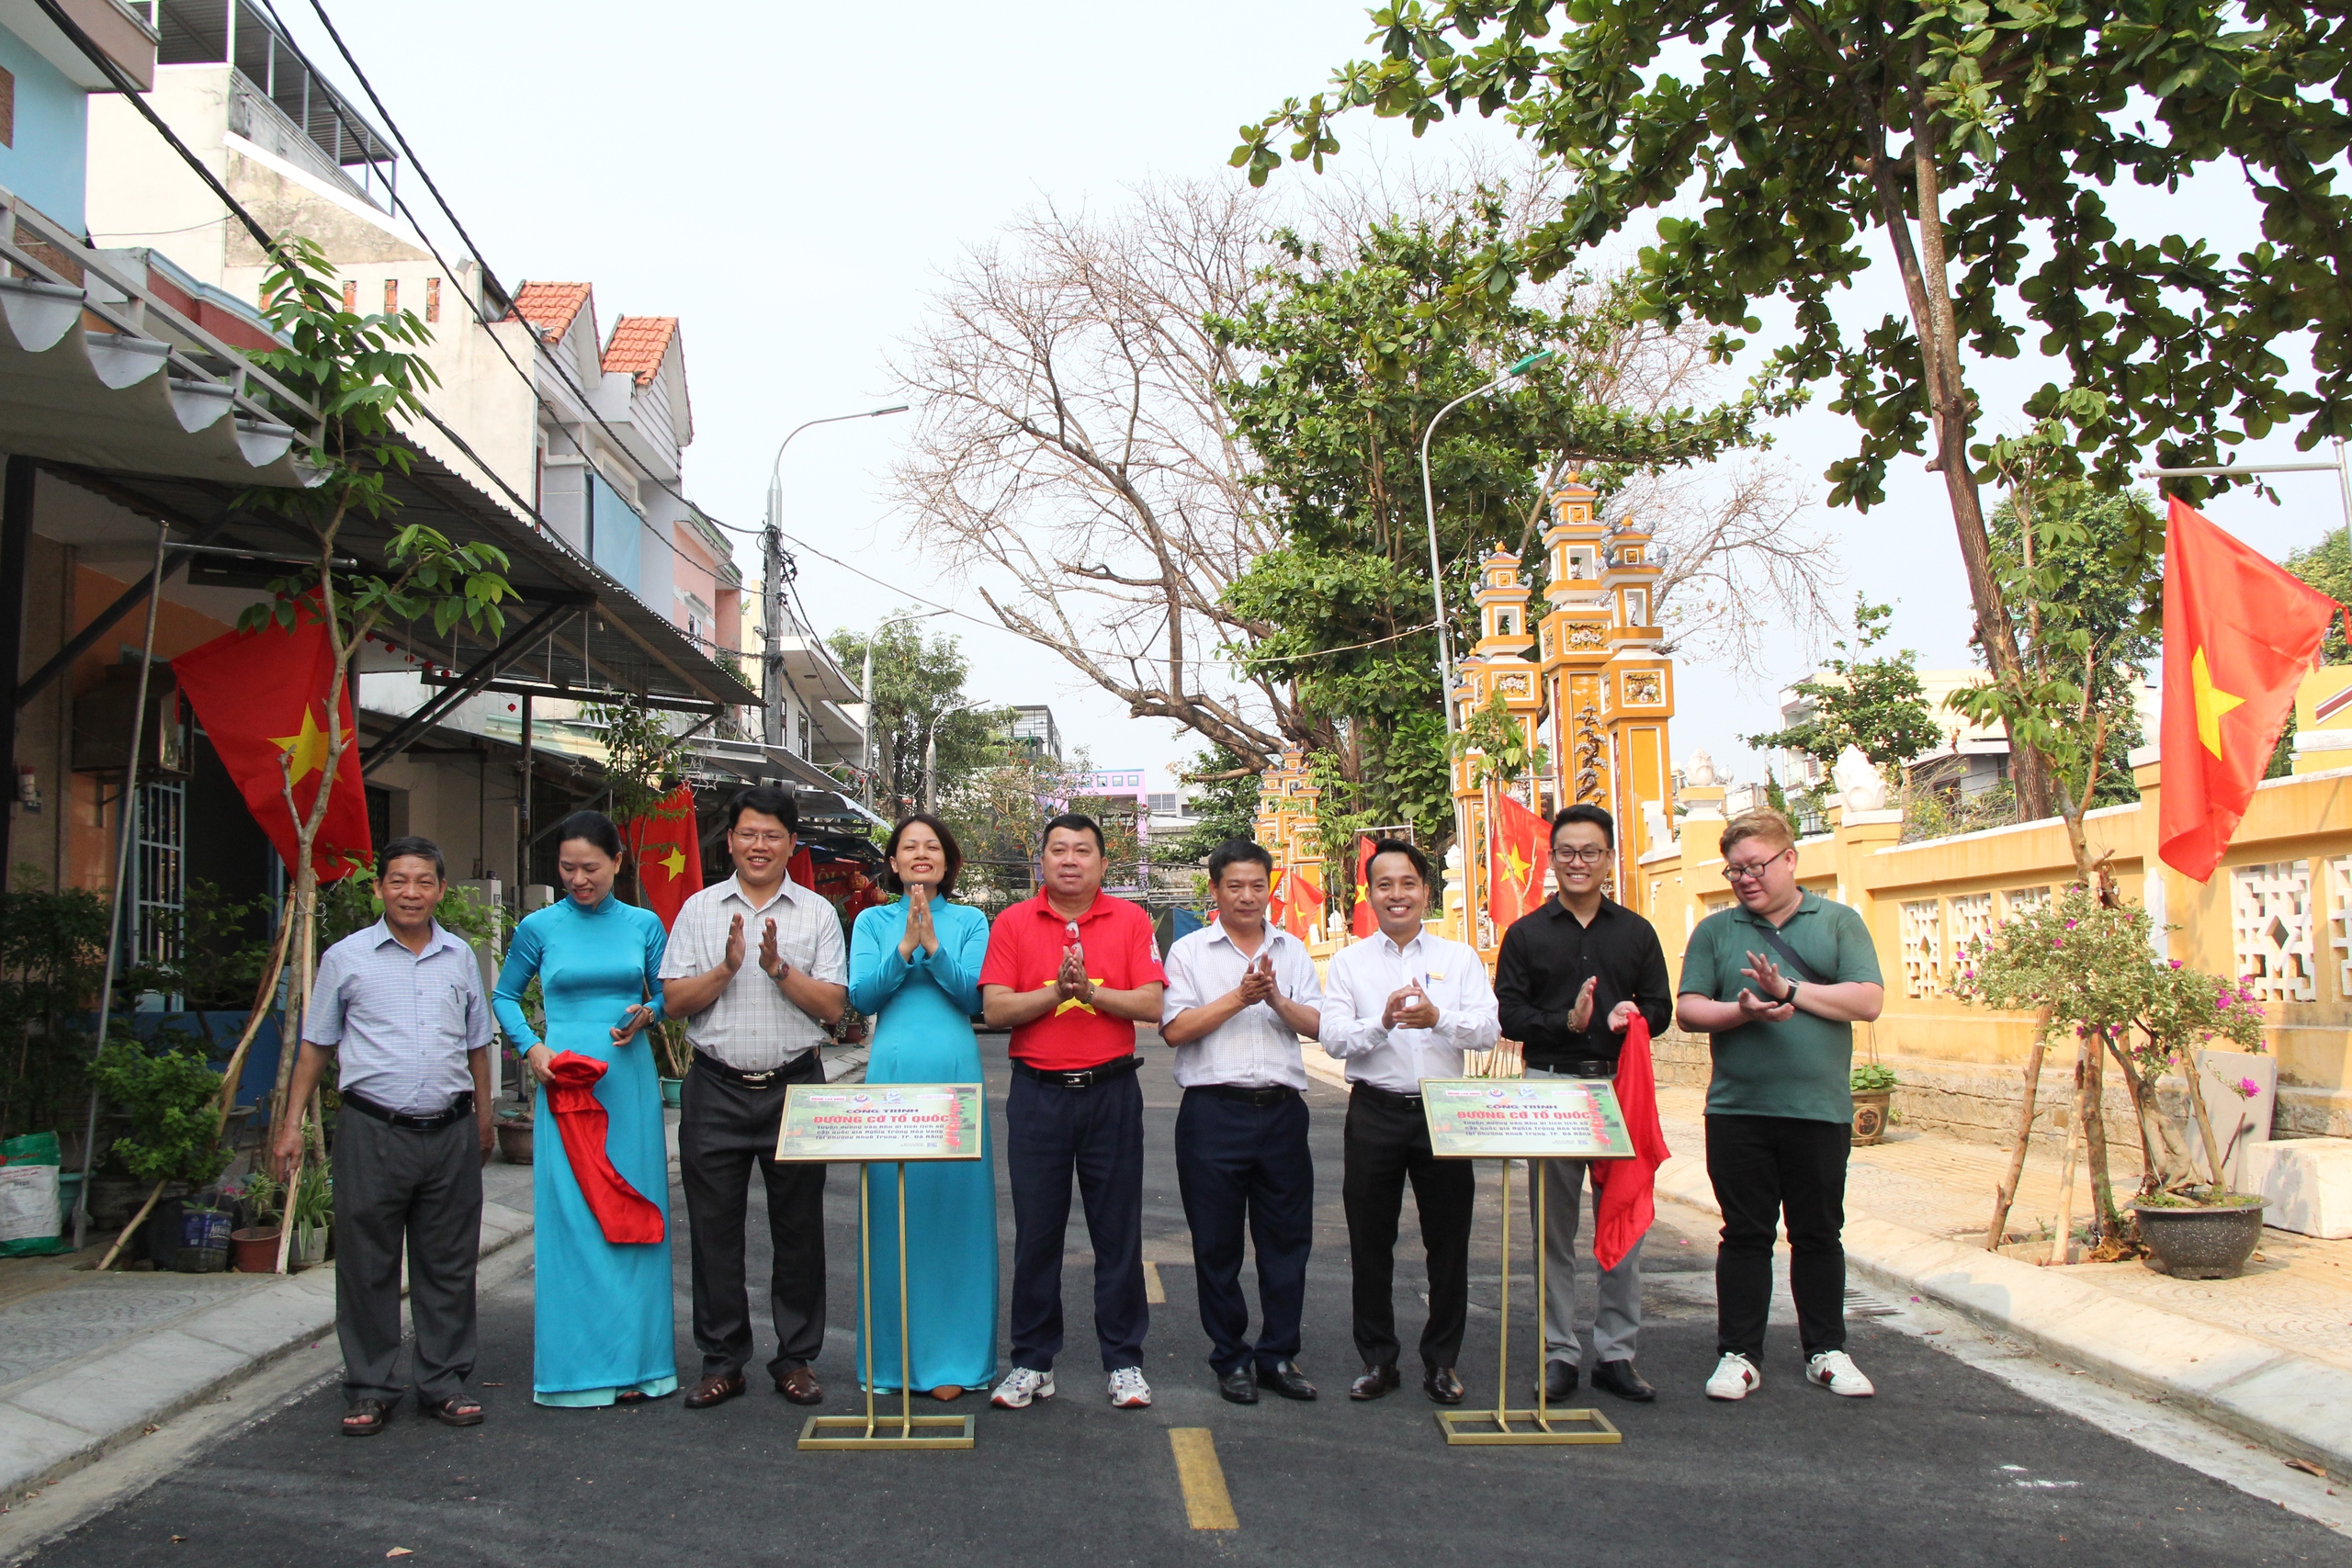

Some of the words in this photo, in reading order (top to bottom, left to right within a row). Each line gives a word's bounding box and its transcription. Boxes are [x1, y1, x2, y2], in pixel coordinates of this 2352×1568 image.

[813, 1114, 863, 1123] ĐƯỜNG
[866, 1114, 887, 1123] CỜ
[890, 1113, 909, 1123] TỔ
[911, 1113, 950, 1123] QUỐC
[1457, 1111, 1506, 1119] ĐƯỜNG
[1510, 1111, 1529, 1119] CỜ
[1532, 1110, 1550, 1119] TỔ
[1554, 1110, 1591, 1119] QUỐC
